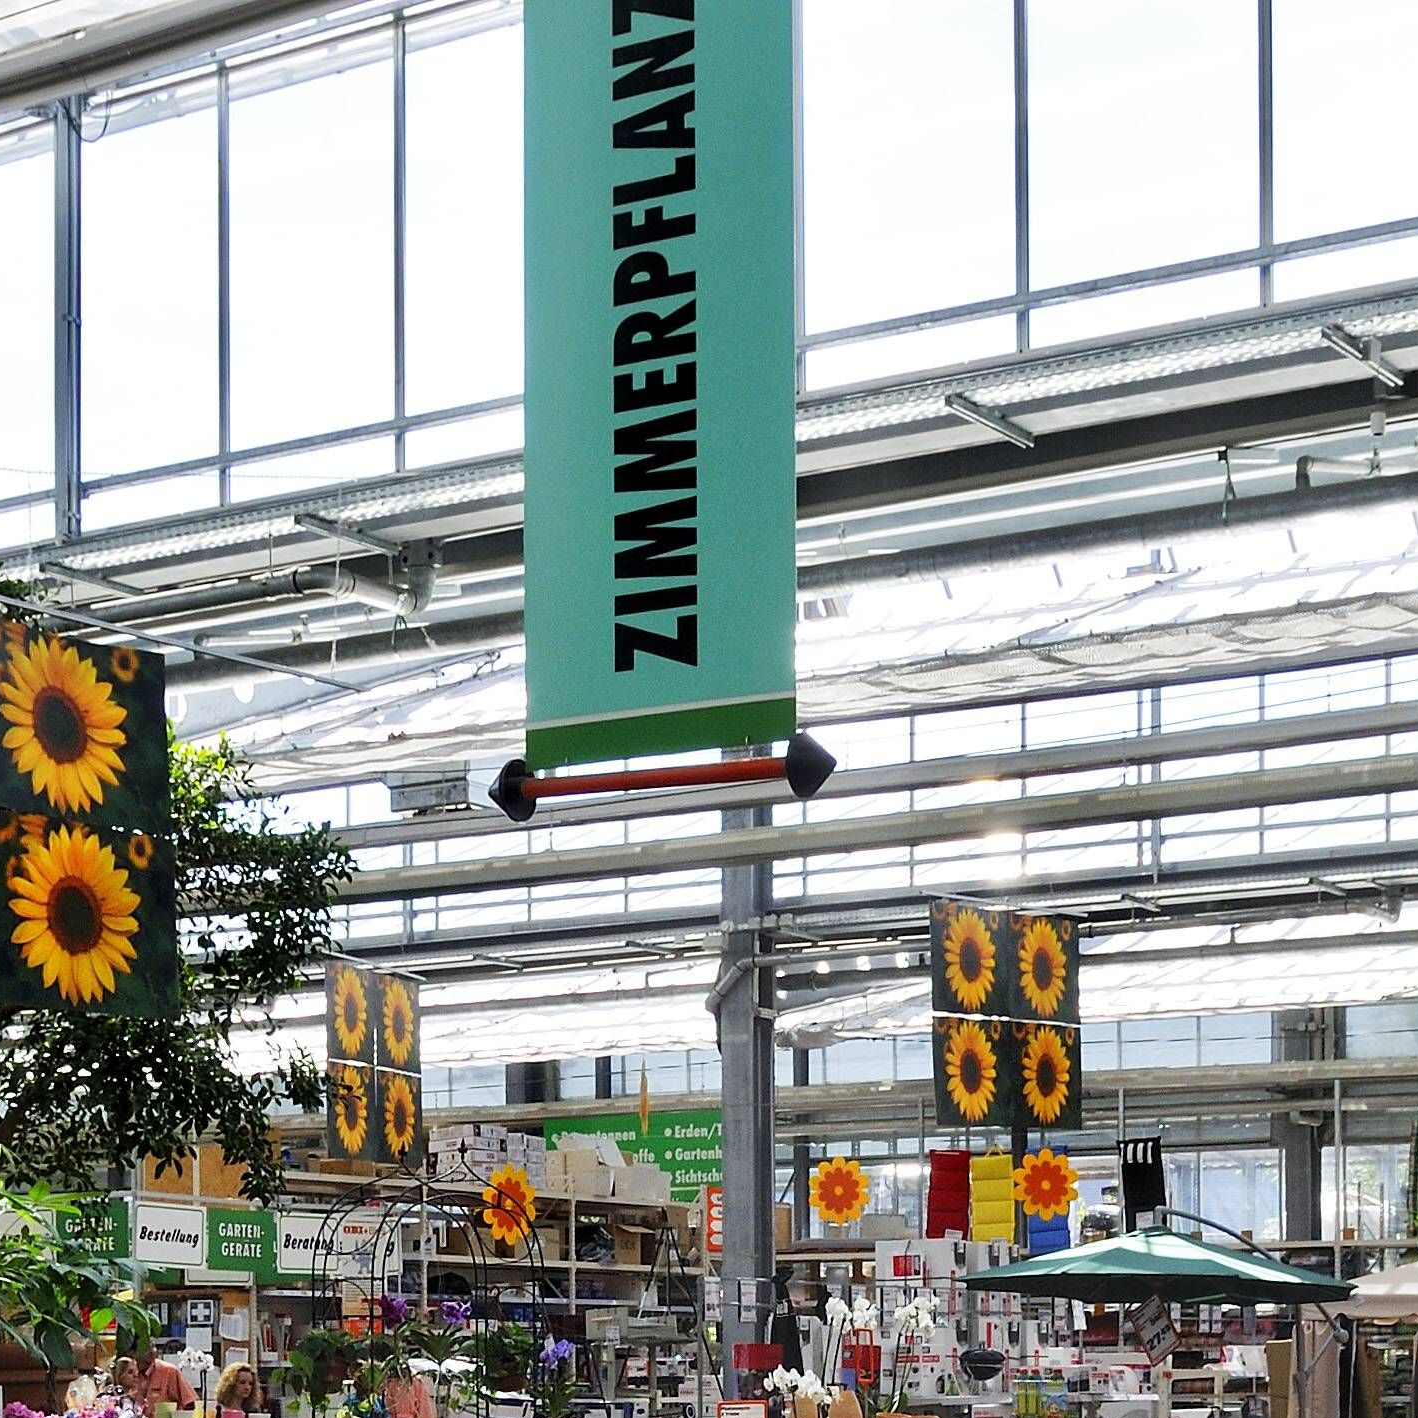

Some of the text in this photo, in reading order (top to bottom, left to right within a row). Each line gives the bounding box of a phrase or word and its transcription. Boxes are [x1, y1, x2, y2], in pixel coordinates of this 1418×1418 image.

[611, 0, 699, 673] ZIMMERPFLANZ
[139, 1225, 199, 1248] Bestellung
[218, 1222, 265, 1237] GARTEN-
